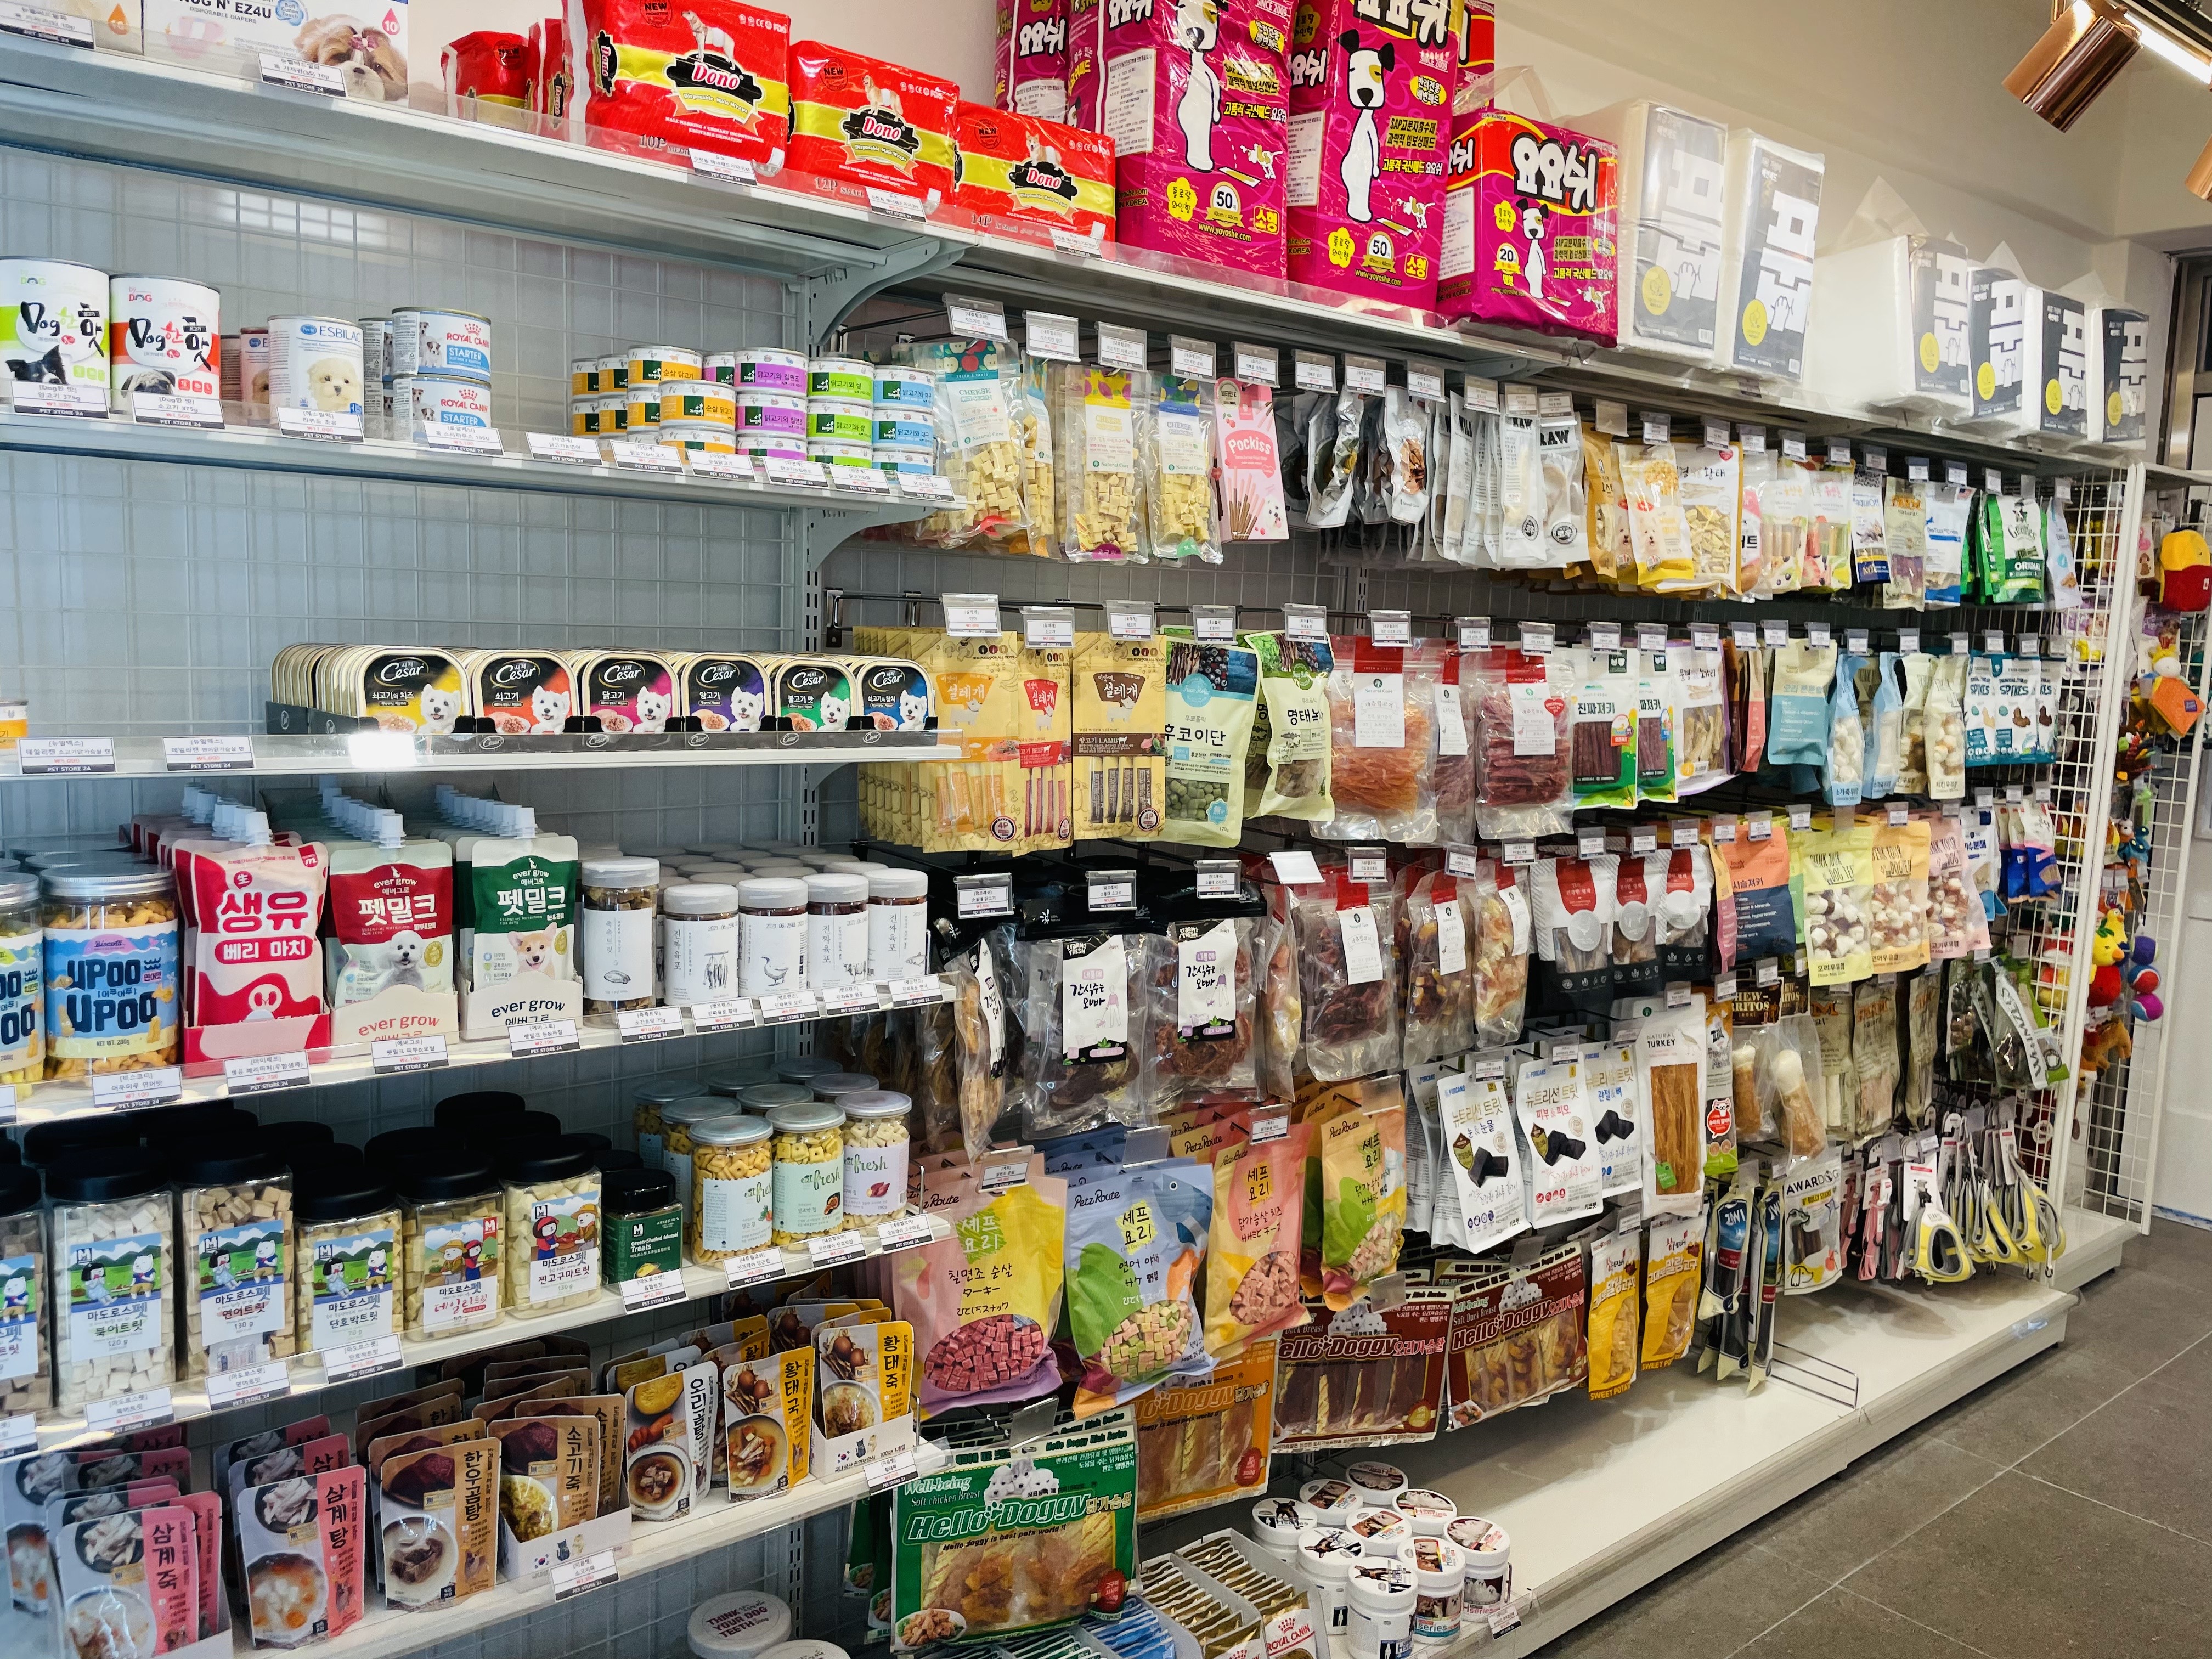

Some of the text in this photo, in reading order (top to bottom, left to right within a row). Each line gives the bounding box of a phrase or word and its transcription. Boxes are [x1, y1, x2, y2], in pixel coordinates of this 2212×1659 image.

[189, 6, 257, 24] DISPOSABLE DIAPERS
[235, 2, 272, 19] EZ4U
[645, 2, 668, 12] NEW
[385, 20, 397, 32] 10
[691, 61, 740, 89] Dono
[823, 66, 844, 76] NEW
[683, 93, 748, 114] Disposable Male Wraps
[862, 116, 901, 142] Dono
[639, 133, 666, 149] 10P
[1026, 168, 1062, 189] Dono
[1216, 193, 1233, 208] 50
[971, 214, 992, 226] 14P
[1198, 222, 1251, 242] www.yoyoshe.com
[1499, 249, 1514, 262] 20
[319, 326, 361, 343] ESBILAC
[446, 332, 489, 347] ROYAL CANIN
[449, 348, 482, 361] STARTER
[757, 371, 782, 380] 닭고기와
[958, 387, 991, 396] CHEESE
[441, 398, 488, 413] ROYAL CANIN
[443, 413, 478, 426] STARTER
[972, 432, 990, 441] Natural
[1228, 436, 1272, 455] Pockiss
[381, 662, 424, 682] Cesar
[495, 662, 536, 684] Cesar
[603, 662, 642, 684] Cesar
[701, 665, 736, 684] Cesar
[791, 672, 825, 689] Cesar
[873, 671, 903, 687] Cesar
[399, 691, 414, 699] 치즈
[495, 692, 519, 701] 쇠고기
[602, 690, 625, 701] 닭고기
[699, 691, 721, 700] 양고기
[788, 695, 806, 703] 불고기
[947, 683, 985, 701] 설레개
[1032, 690, 1055, 707] 설레개
[1102, 682, 1138, 699] 설레개
[1999, 685, 2029, 696] SPIKES
[1079, 736, 1118, 744] 양고기 LAMB
[1164, 724, 1227, 747] 후코이단
[236, 874, 250, 885] 生
[374, 877, 417, 889] ever grow
[512, 869, 549, 880] ever grow
[358, 894, 437, 926] 펫밀크
[497, 886, 566, 916] 펫밀크
[220, 891, 309, 933] 생유
[223, 940, 306, 960] 베리 마치
[67, 958, 141, 991] UPOO
[66, 991, 157, 1033] UPOO
[491, 1000, 566, 1018] ever grow
[1083, 997, 1106, 1010] 오빠
[359, 1015, 440, 1036] ever grow
[1646, 1032, 1674, 1041] NATURAL
[1647, 1039, 1675, 1048] TURKEY
[1525, 1083, 1579, 1106] 뉴트리션 트릿
[1452, 1096, 1504, 1127] 뉴트리션 트릿
[854, 1155, 888, 1175] fresh
[1095, 1189, 1120, 1203] Route
[963, 1236, 998, 1254] 요리
[1124, 1226, 1151, 1246] 요리
[631, 1243, 652, 1252] Treats
[947, 1263, 1013, 1283] 칠면조 순살
[215, 1285, 271, 1305] 마도로스펫
[439, 1282, 482, 1296] 마도로스펫
[87, 1301, 149, 1322] 마도로스펫
[222, 1301, 266, 1320] 연어트릿
[234, 1321, 247, 1330] 130
[1452, 1320, 1499, 1351] Hello
[1500, 1299, 1551, 1334] Doggy
[883, 1335, 900, 1390] 황태죽
[783, 1361, 800, 1414] 황태국
[566, 1426, 583, 1491] 소고기죽
[463, 1450, 483, 1521] 한우곰탕
[904, 1477, 972, 1495] Well-being
[911, 1488, 981, 1508] Soft chicken Breast
[325, 1482, 350, 1550] 삼계탕
[907, 1492, 1133, 1542] Hello Doggy 닭가슴살
[943, 1542, 963, 1551] Hello
[989, 1536, 997, 1544] is
[1000, 1532, 1017, 1541] best
[1019, 1528, 1037, 1539] pets
[1039, 1526, 1059, 1536] world
[151, 1523, 178, 1591] 삼계죽
[706, 1609, 741, 1626] THINK
[713, 1606, 768, 1631] YOUR DOG
[719, 1621, 755, 1638] TEETH
[1267, 1624, 1311, 1654] ROYAL CANIN
